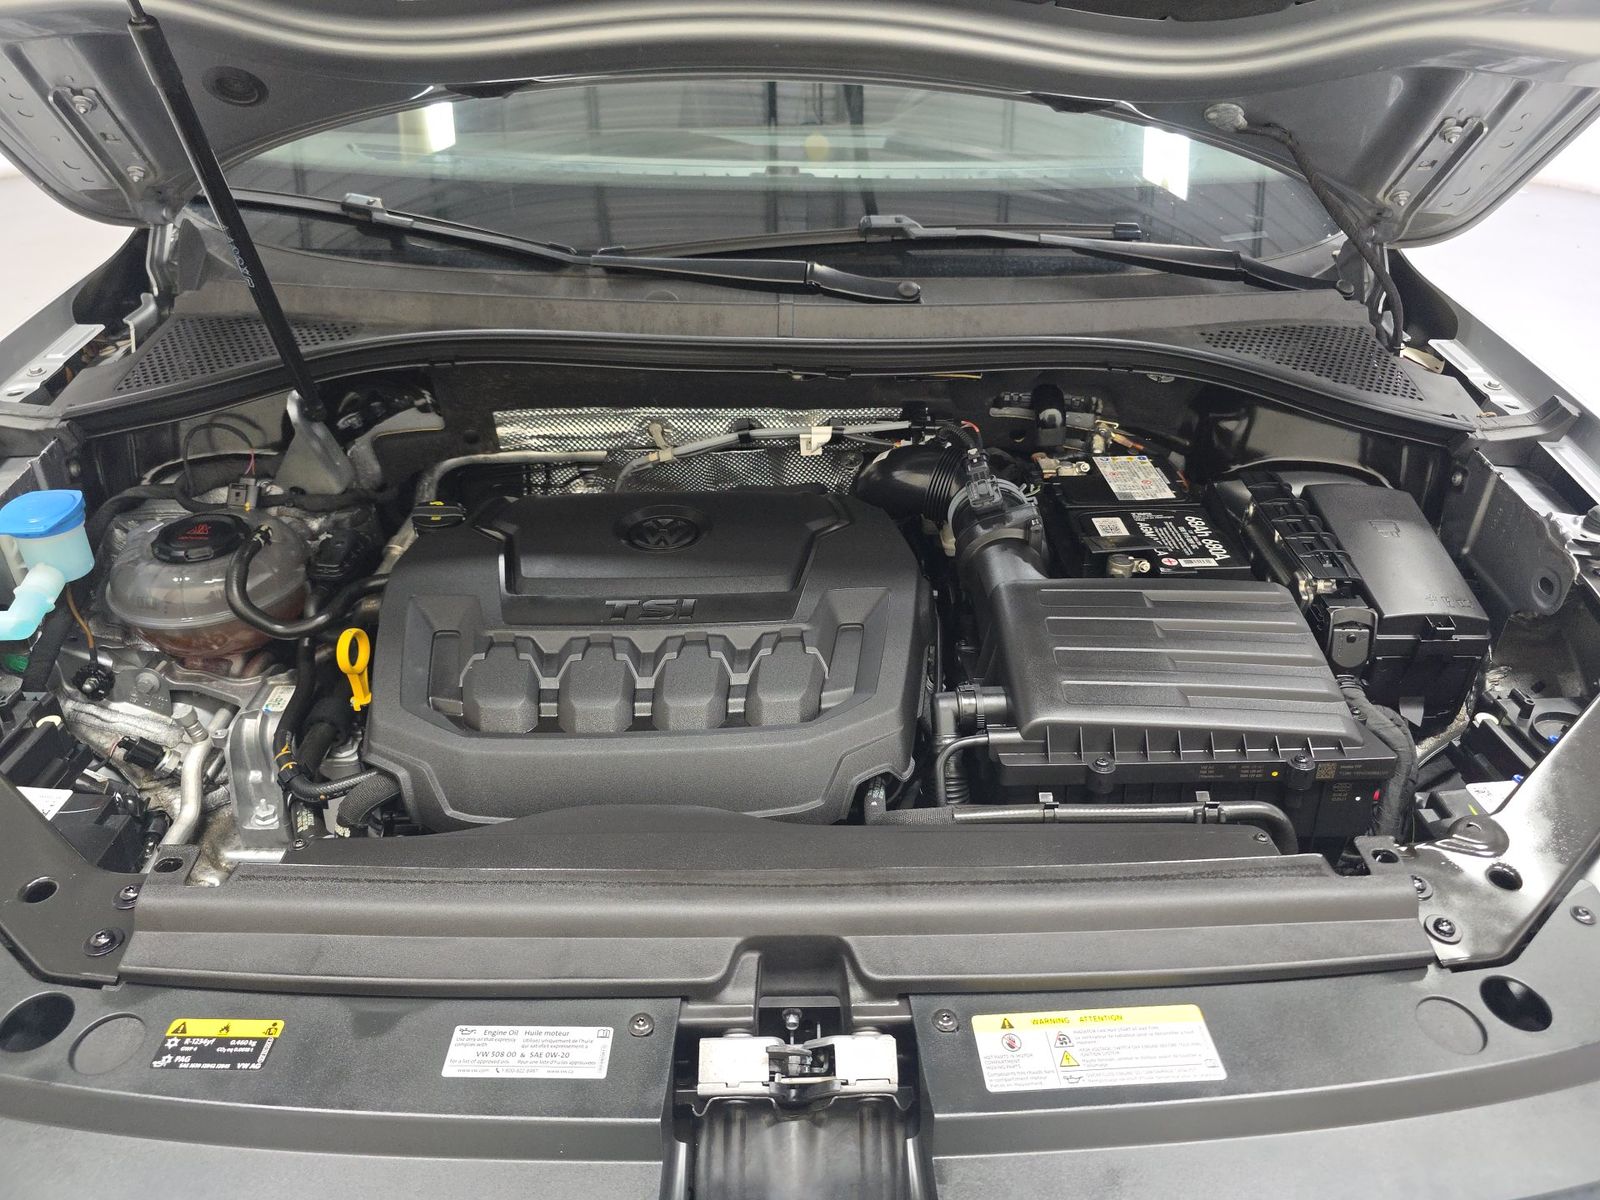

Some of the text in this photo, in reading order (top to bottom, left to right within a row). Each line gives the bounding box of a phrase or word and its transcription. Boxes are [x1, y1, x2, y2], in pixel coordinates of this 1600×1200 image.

[1184, 516, 1213, 537] 68Ah
[1201, 538, 1231, 560] 680A
[605, 599, 697, 620] TSI
[1031, 1014, 1124, 1025] WARNING ATTENTION
[483, 1029, 508, 1037] Engine
[183, 1038, 217, 1046] R-1234yf
[174, 1055, 192, 1063] PAG
